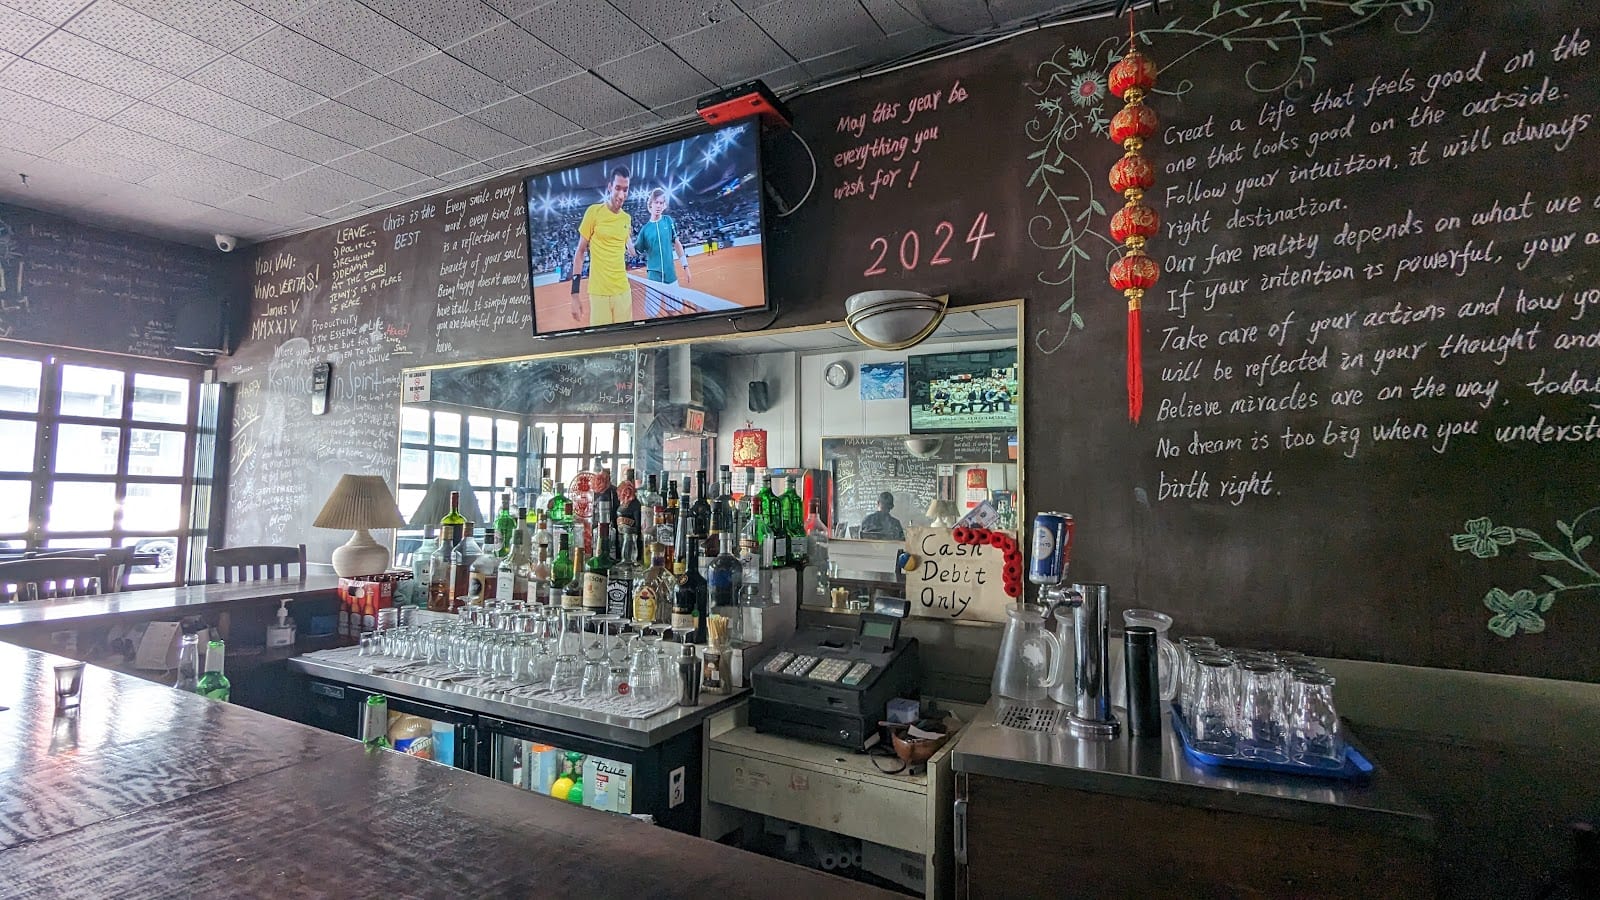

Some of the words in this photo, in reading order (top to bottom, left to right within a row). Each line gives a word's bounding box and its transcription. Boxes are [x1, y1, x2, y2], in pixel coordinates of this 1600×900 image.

[872, 101, 901, 124] this
[902, 89, 942, 124] year
[948, 79, 969, 104] be
[1164, 115, 1215, 145] Creat
[1230, 119, 1246, 131] a
[1311, 83, 1354, 114] that
[1363, 67, 1416, 107] feels
[1421, 50, 1486, 103] good
[1504, 50, 1535, 73] on
[1552, 27, 1591, 61] the
[1166, 155, 1197, 174] one
[1207, 143, 1246, 168] that
[1253, 131, 1299, 159] looks
[1306, 114, 1355, 158] good
[1370, 118, 1395, 134] on
[1407, 106, 1446, 128] the
[1462, 76, 1569, 117] outside.
[834, 134, 909, 170] everything
[912, 126, 939, 154] you
[1166, 179, 1227, 208] Follow
[1233, 168, 1280, 205] your
[1409, 141, 1431, 167] it
[1443, 125, 1493, 158] will
[1502, 114, 1592, 152] always
[445, 198, 466, 218] Every
[494, 182, 516, 206] every
[834, 175, 865, 200] wish
[869, 168, 901, 200] for
[409, 209, 419, 223] is
[421, 204, 436, 219] the
[469, 212, 489, 231] every
[491, 203, 510, 219] kind
[1166, 210, 1213, 247] right
[1226, 198, 1348, 230] destination.
[341, 240, 377, 255] POLITICS
[394, 231, 421, 250] BEST
[443, 241, 451, 253] is
[461, 229, 500, 254] reflection
[502, 224, 513, 240] of
[864, 211, 996, 277] 2024
[1165, 255, 1197, 273] Our
[1253, 233, 1319, 259] reality
[1333, 209, 1423, 253] depends
[1435, 216, 1461, 232] on
[1472, 191, 1536, 226] what
[1546, 196, 1582, 213] we
[340, 260, 368, 279] DRAMA
[440, 259, 468, 276] beauty
[471, 253, 481, 278] of
[485, 251, 501, 271] your
[1167, 279, 1195, 318] If
[1203, 278, 1249, 311] your
[1260, 260, 1354, 291] intention
[1363, 262, 1384, 280] is
[1517, 232, 1577, 271] your
[331, 282, 344, 291] AT
[346, 273, 361, 286] THE
[437, 284, 455, 299] Being
[484, 294, 508, 314] simply
[1160, 326, 1208, 351] Take
[1218, 326, 1258, 346] care
[1268, 311, 1295, 347] of
[1306, 311, 1357, 345] your
[1363, 302, 1446, 326] actions
[1457, 286, 1505, 318] and
[1516, 289, 1564, 313] how
[460, 313, 490, 332] thankful
[492, 313, 505, 333] for
[507, 310, 519, 324] all
[1161, 359, 1202, 382] will
[1213, 359, 1233, 382] be
[1245, 346, 1328, 387] reflected
[1341, 352, 1364, 371] in
[1371, 341, 1427, 376] your
[1438, 321, 1541, 365] thought
[1157, 392, 1222, 422] Believe
[1230, 381, 1318, 414] miracles
[1331, 389, 1364, 407] are
[1377, 385, 1402, 400] on
[1411, 375, 1446, 400] the
[1155, 437, 1180, 458] No
[1188, 430, 1242, 455] dream
[1251, 431, 1269, 450] is
[1281, 426, 1315, 450] too
[1322, 421, 1360, 458] big
[1372, 418, 1428, 441] when
[1432, 420, 1479, 454] you
[1158, 470, 1209, 501] birth
[921, 560, 987, 585] Debit
[921, 587, 972, 618] Only
